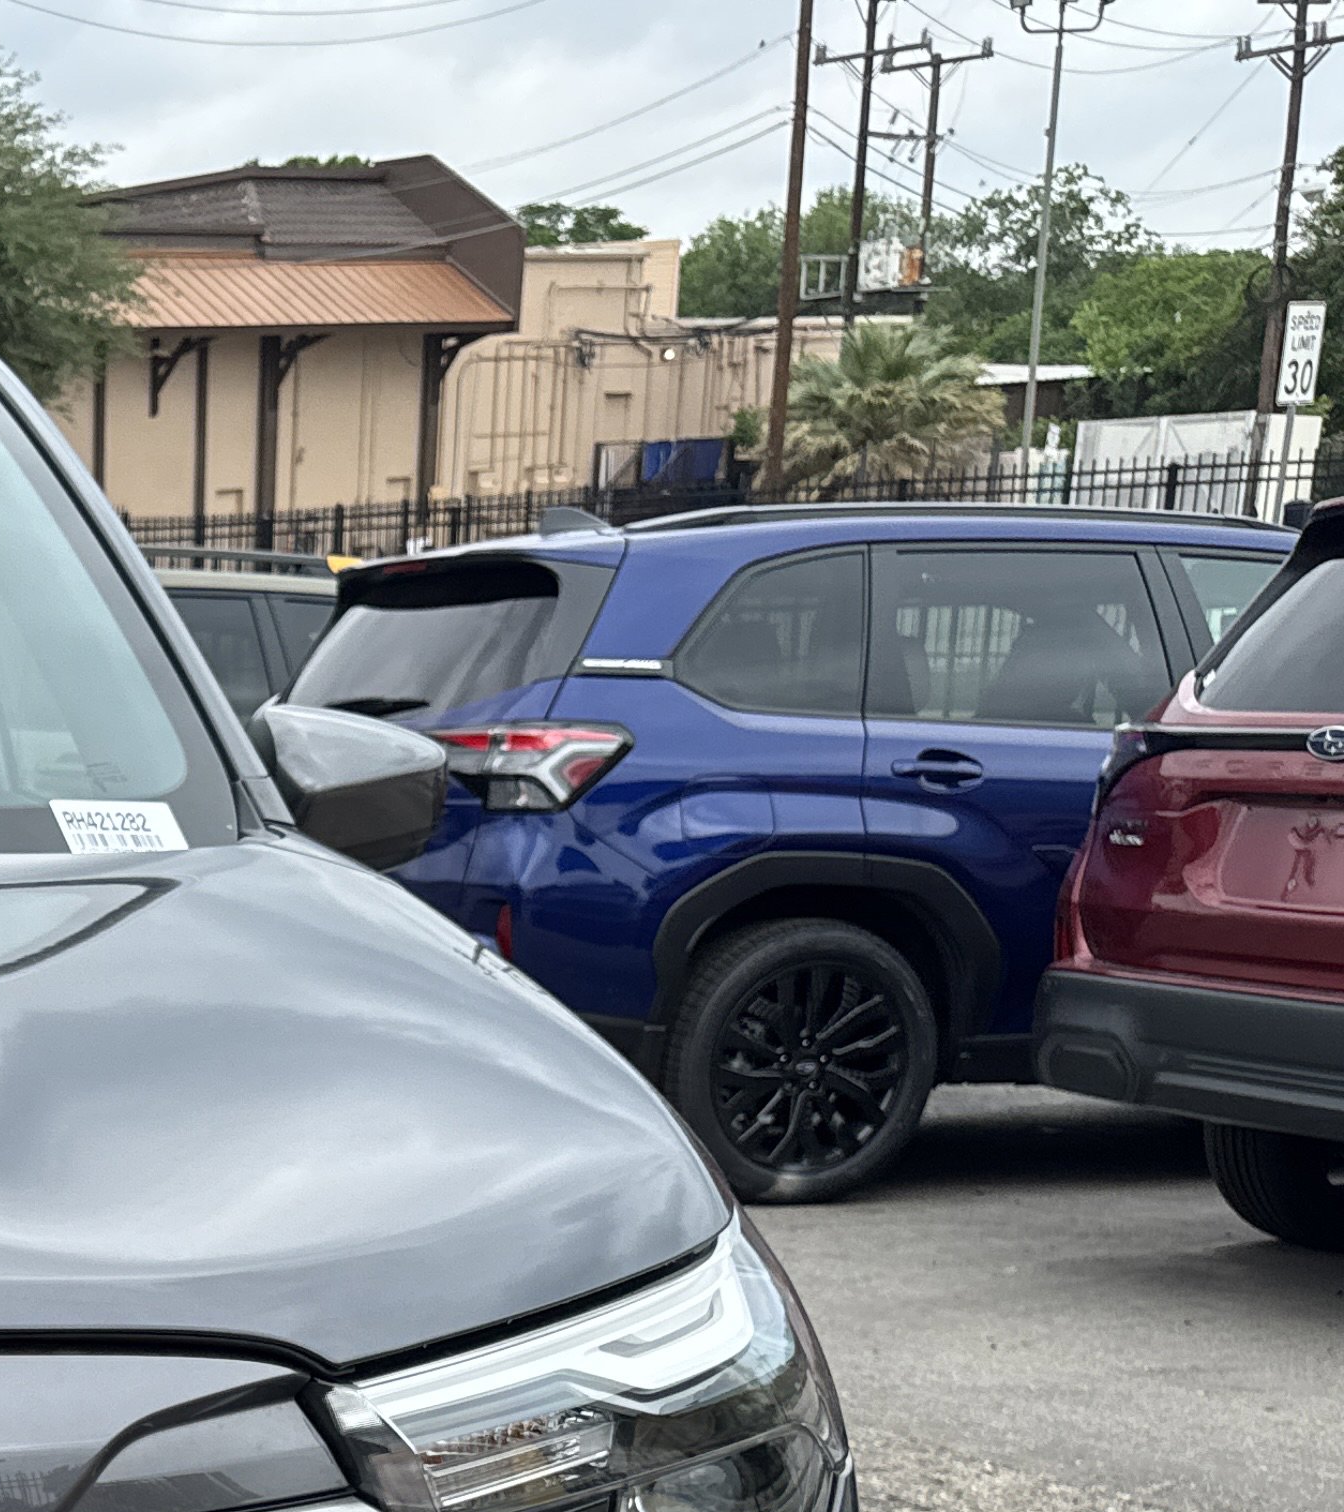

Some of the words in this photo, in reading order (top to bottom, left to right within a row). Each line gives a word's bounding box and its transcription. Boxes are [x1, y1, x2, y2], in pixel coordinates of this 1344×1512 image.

[1290, 312, 1321, 331] SPEED
[1291, 335, 1317, 351] LIMIT
[1284, 359, 1313, 395] 30
